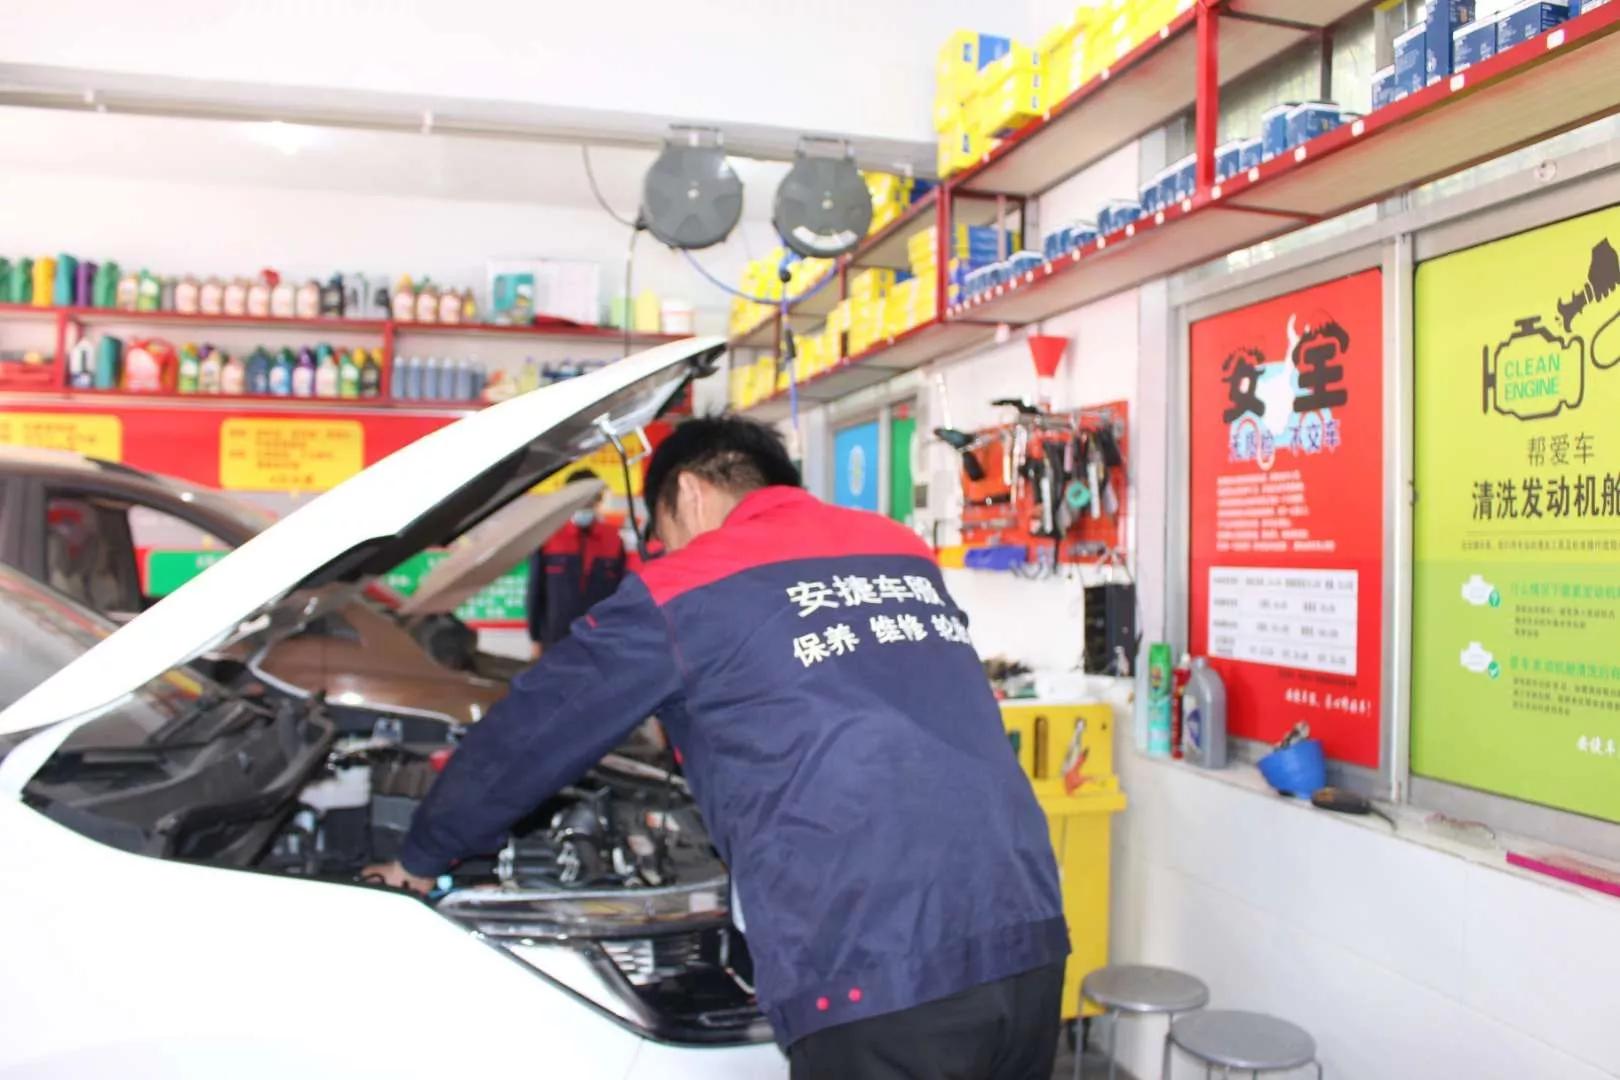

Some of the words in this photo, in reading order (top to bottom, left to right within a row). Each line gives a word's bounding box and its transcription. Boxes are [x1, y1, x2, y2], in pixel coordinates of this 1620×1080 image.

[1222, 320, 1350, 424] 安全
[1504, 353, 1561, 378] CLEAN
[1504, 378, 1560, 401] ENGINE
[1528, 432, 1595, 467] 帮爱车
[793, 623, 860, 668] 保养
